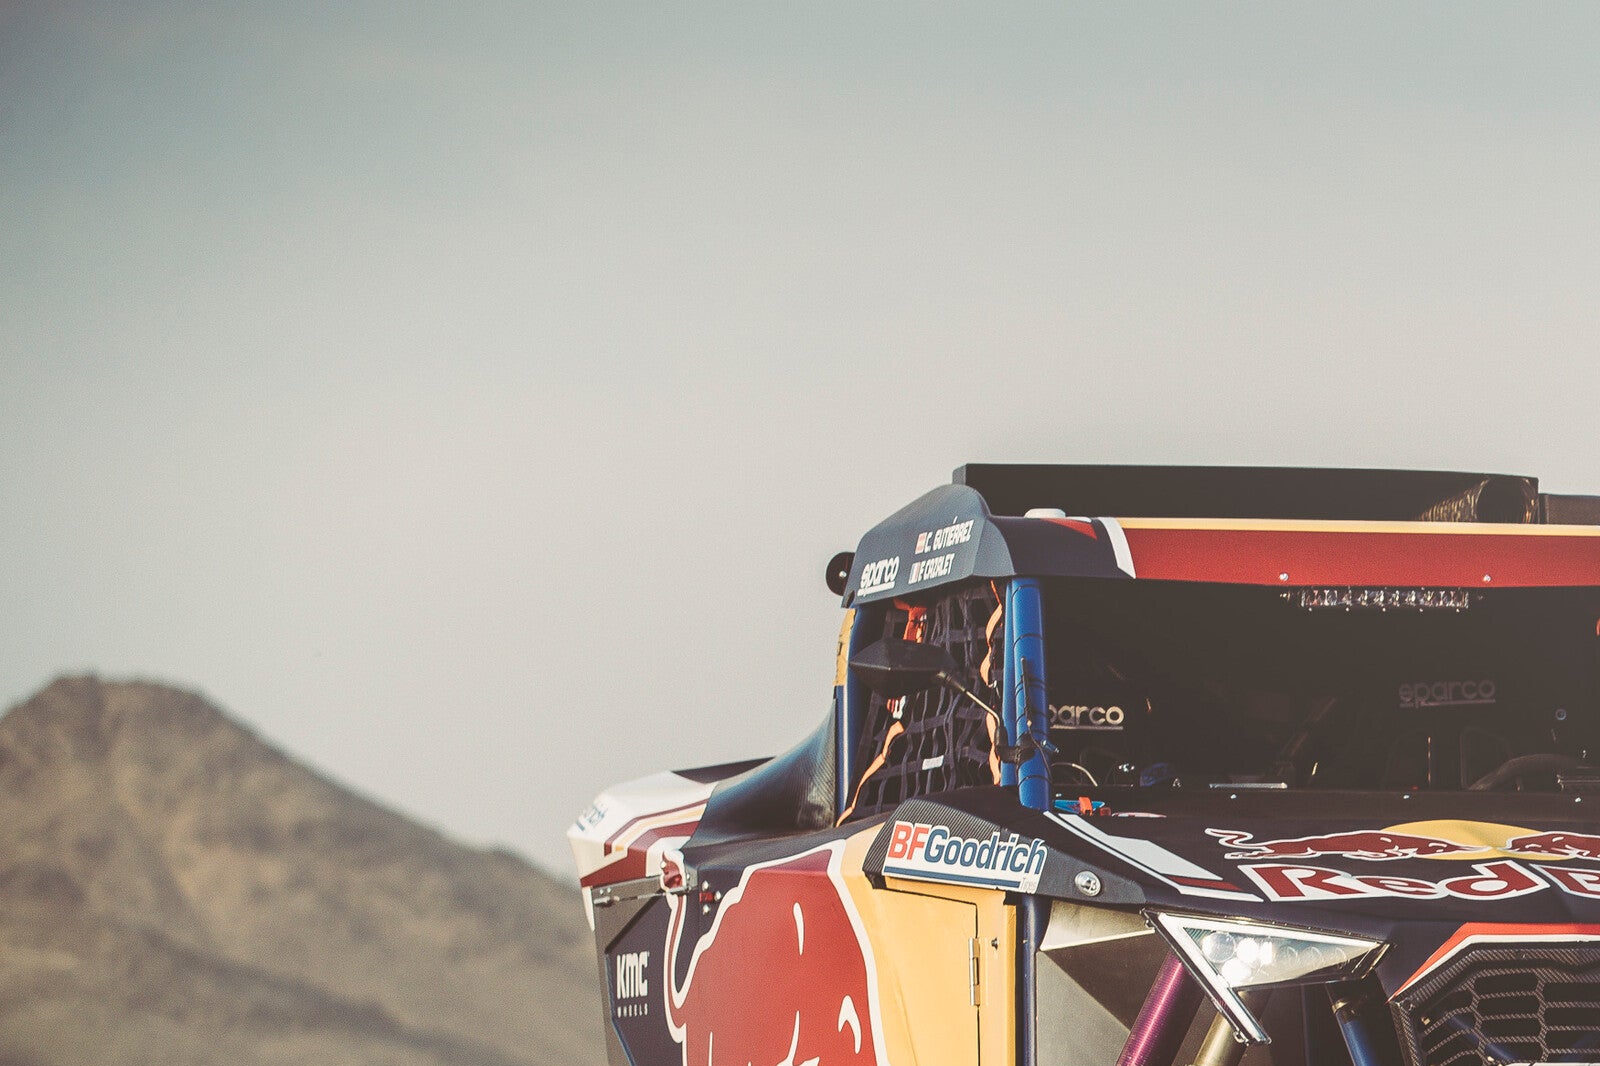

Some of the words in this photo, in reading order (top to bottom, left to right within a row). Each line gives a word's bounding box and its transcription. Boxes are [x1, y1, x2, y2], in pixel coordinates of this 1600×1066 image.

[860, 556, 900, 592] sparco
[1399, 680, 1496, 706] sparco
[887, 822, 1047, 876] BFGoodrich
[1238, 860, 1551, 902] Red
[617, 951, 648, 999] KMC
